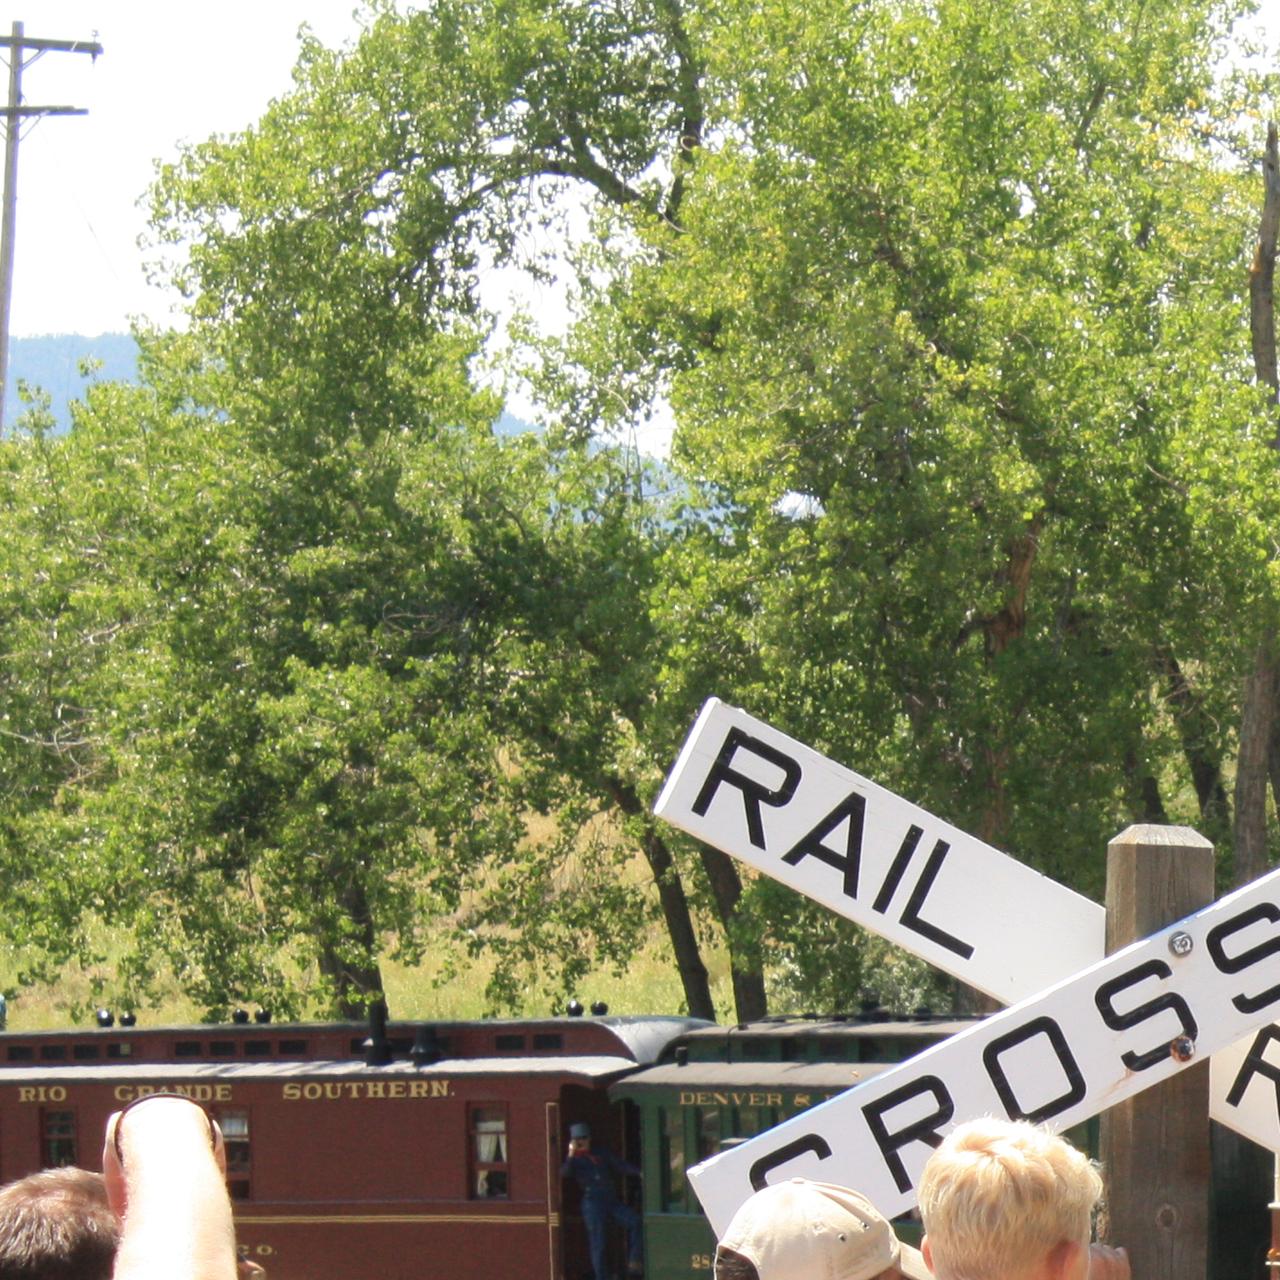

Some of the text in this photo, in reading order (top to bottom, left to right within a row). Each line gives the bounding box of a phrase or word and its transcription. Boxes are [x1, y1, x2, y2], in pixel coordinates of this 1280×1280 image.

[691, 725, 976, 961] RAIL
[18, 1086, 67, 1102] RIO
[283, 1080, 455, 1099] SOUTHERN.
[680, 1091, 783, 1106] DENVER
[793, 1095, 811, 1106] &
